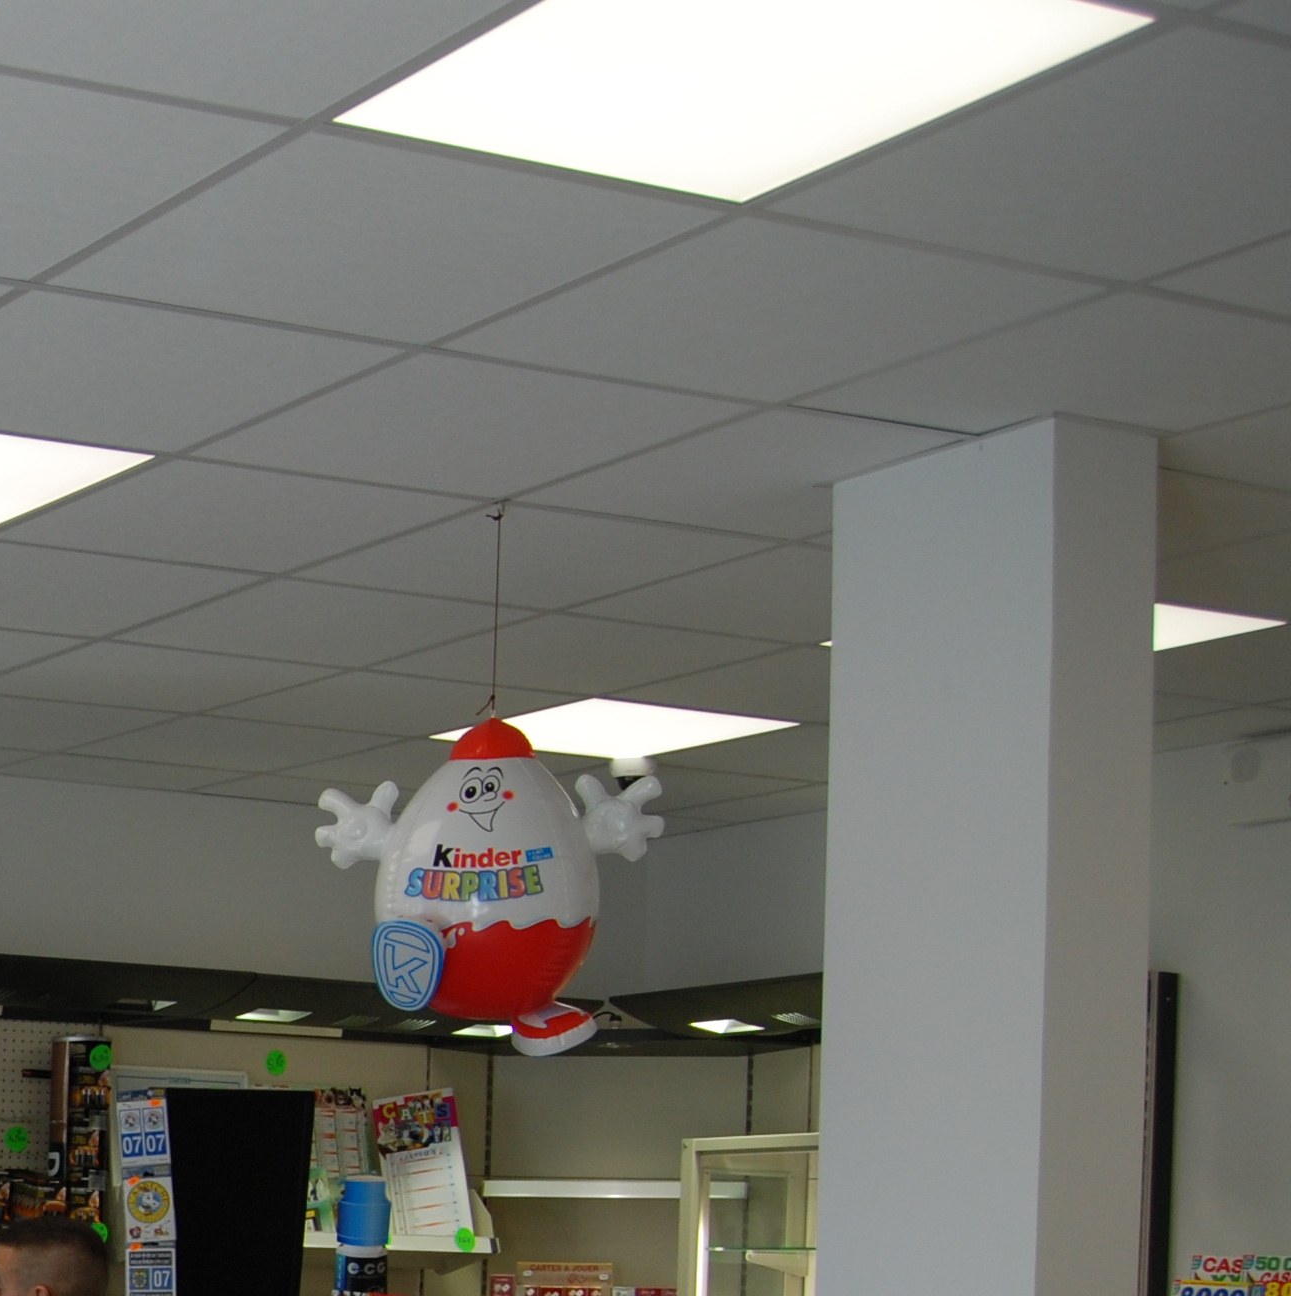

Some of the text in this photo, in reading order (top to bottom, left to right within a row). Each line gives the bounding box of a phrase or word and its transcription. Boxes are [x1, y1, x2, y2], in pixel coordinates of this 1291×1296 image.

[434, 845, 522, 868] Kinder
[405, 865, 543, 901] SURPRISE
[382, 1101, 450, 1124] CATS
[123, 1135, 142, 1155] 07
[146, 1133, 166, 1154] 07
[154, 1270, 171, 1288] 07
